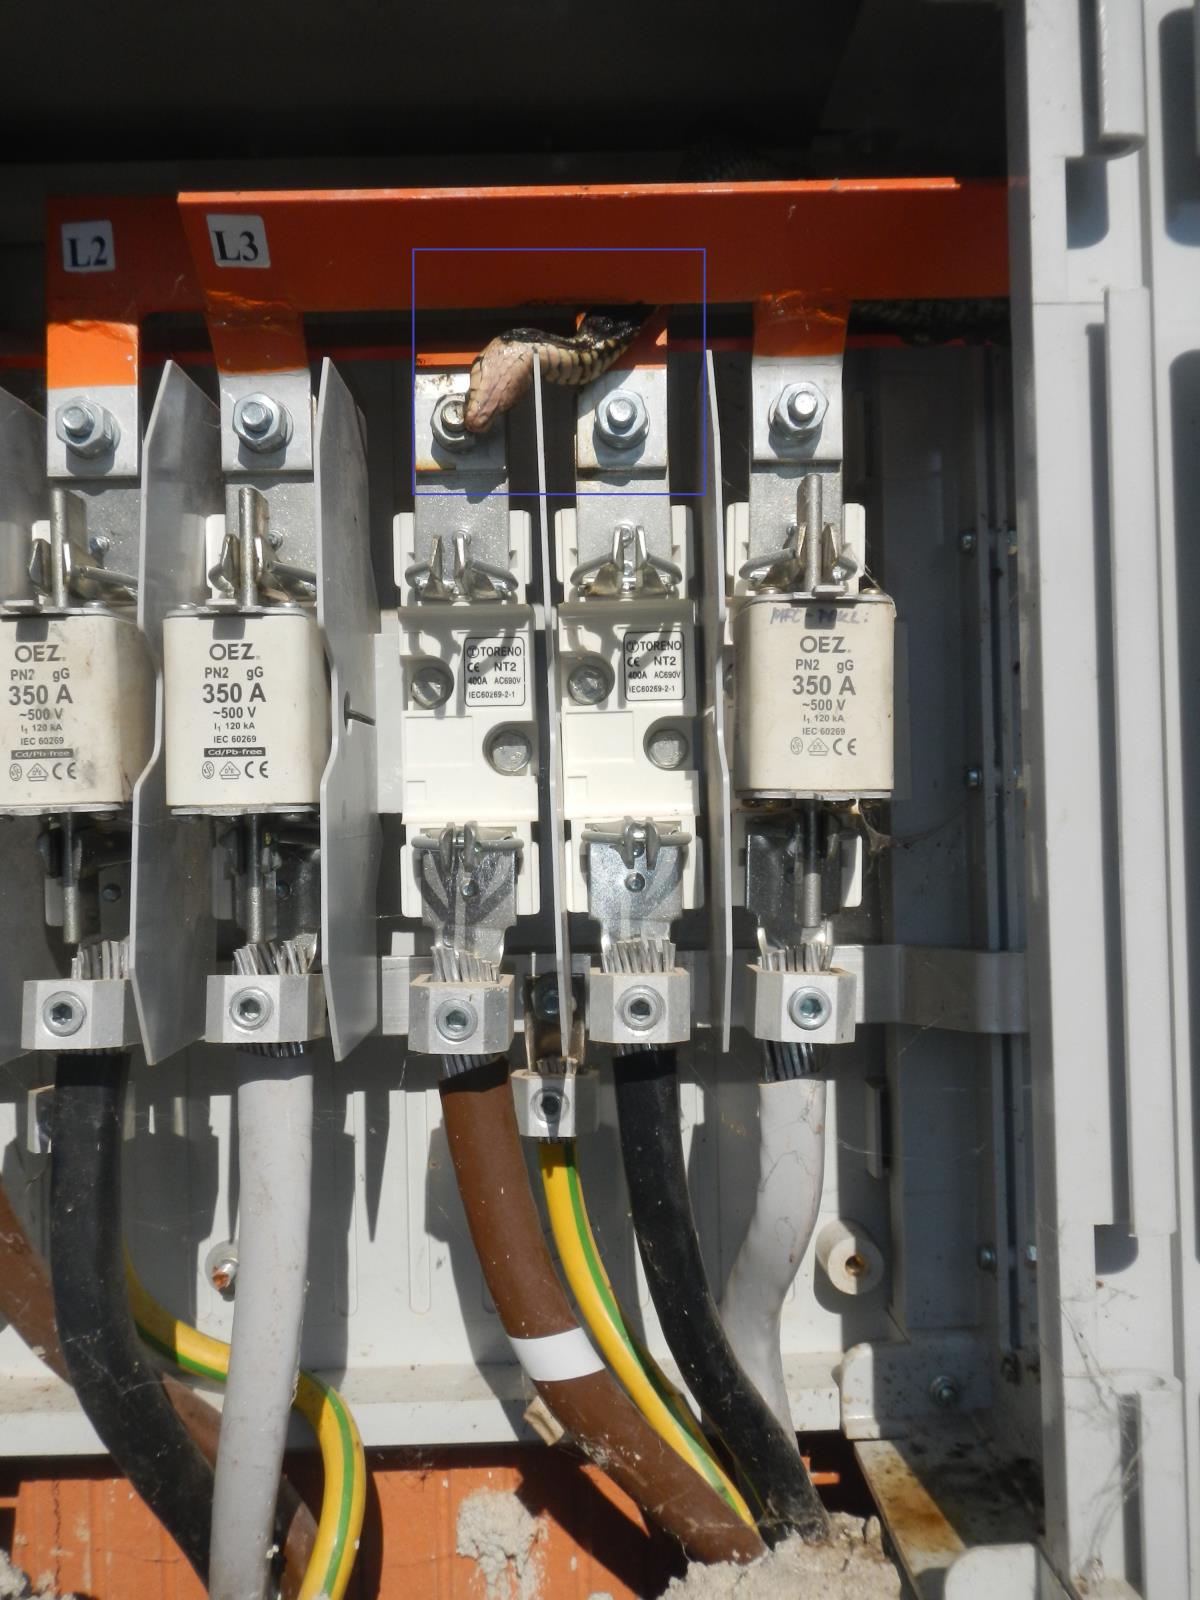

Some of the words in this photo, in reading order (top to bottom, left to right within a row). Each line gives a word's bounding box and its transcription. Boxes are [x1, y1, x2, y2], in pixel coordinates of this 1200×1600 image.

[67, 236, 107, 267] L2
[212, 230, 258, 262] L3
[640, 640, 682, 652] TORENO
[800, 635, 847, 653] OEZ
[14, 644, 61, 663] OEZ
[208, 643, 255, 661] OEZ
[480, 646, 522, 657] TORENO
[494, 661, 517, 672] NT2
[653, 655, 677, 666] NT2
[795, 659, 820, 671] PN2
[836, 659, 854, 674] gG
[10, 668, 35, 681] PN2
[52, 667, 70, 682] gG
[204, 667, 229, 679] PN2
[246, 666, 264, 681] gG
[628, 671, 647, 679] 400A
[654, 670, 681, 679] AC690V
[468, 676, 488, 685] 400A
[792, 675, 832, 696] 350
[838, 675, 857, 696] A
[8, 684, 49, 706] 350
[55, 683, 73, 704] A
[202, 682, 243, 704] 350
[248, 682, 267, 703] A
[468, 690, 516, 699] IEC60269-2-1
[628, 685, 675, 693] IEC60269-2-1
[836, 699, 846, 711] V
[54, 708, 63, 720] V
[247, 706, 256, 718] V
[814, 714, 830, 722] 120
[832, 714, 845, 722] kA
[31, 724, 47, 732] 120
[49, 723, 62, 732] kA
[225, 721, 241, 730] 120
[243, 721, 256, 730] kA
[802, 727, 818, 736] IEC
[820, 727, 846, 736] 60269
[20, 737, 36, 745] IEC
[38, 736, 64, 745] 60269
[213, 735, 229, 744] IEC
[231, 734, 257, 743] 60269
[207, 748, 263, 756] Cd/Pb-free
